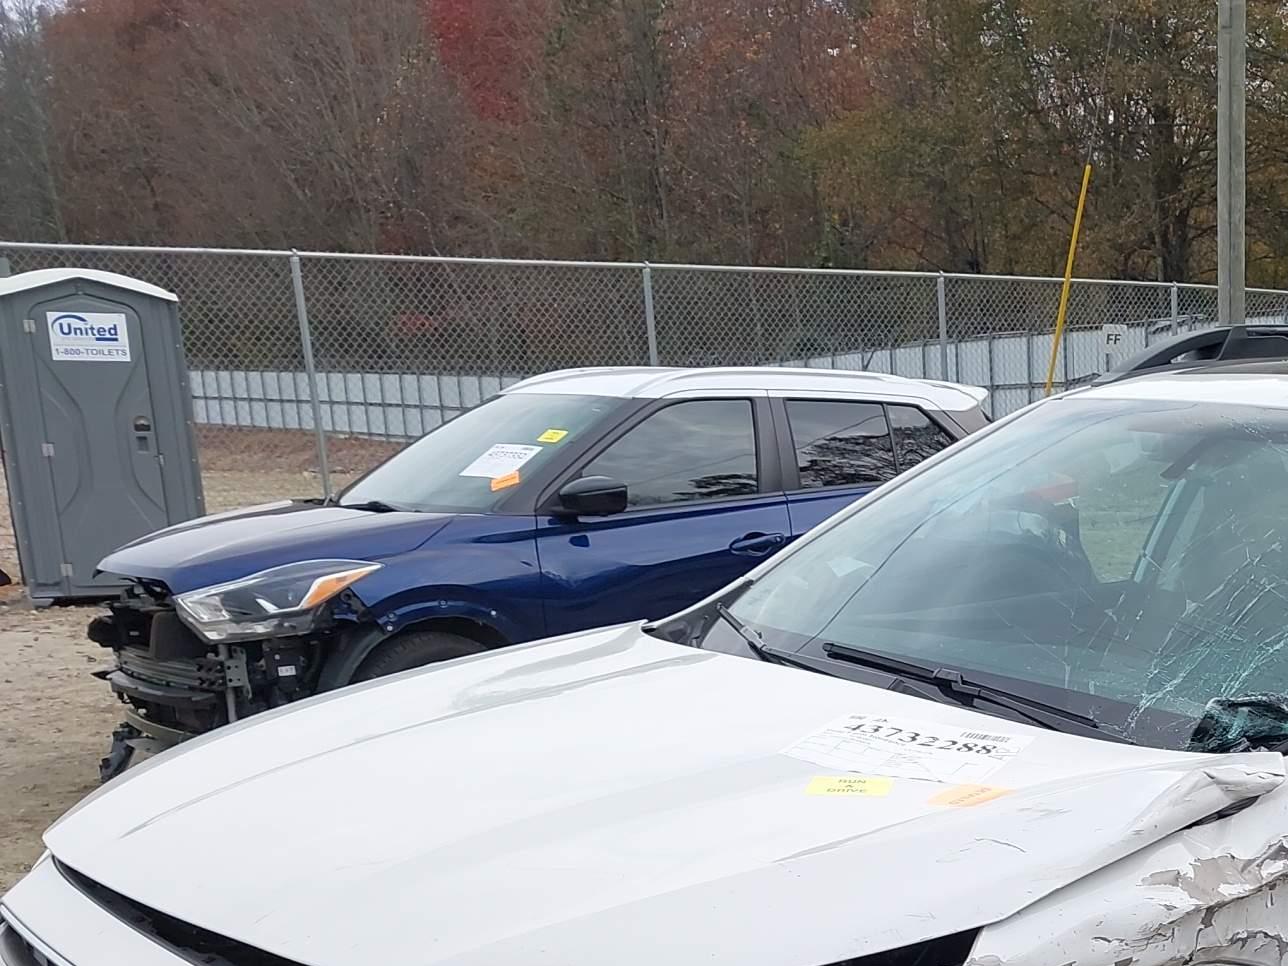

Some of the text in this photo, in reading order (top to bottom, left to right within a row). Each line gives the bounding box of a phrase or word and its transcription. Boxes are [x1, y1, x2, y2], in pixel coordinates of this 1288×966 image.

[58, 323, 119, 337] United
[1106, 333, 1121, 345] FF
[55, 347, 128, 358] 1-800-TOILETS
[843, 723, 997, 754] 43732288
